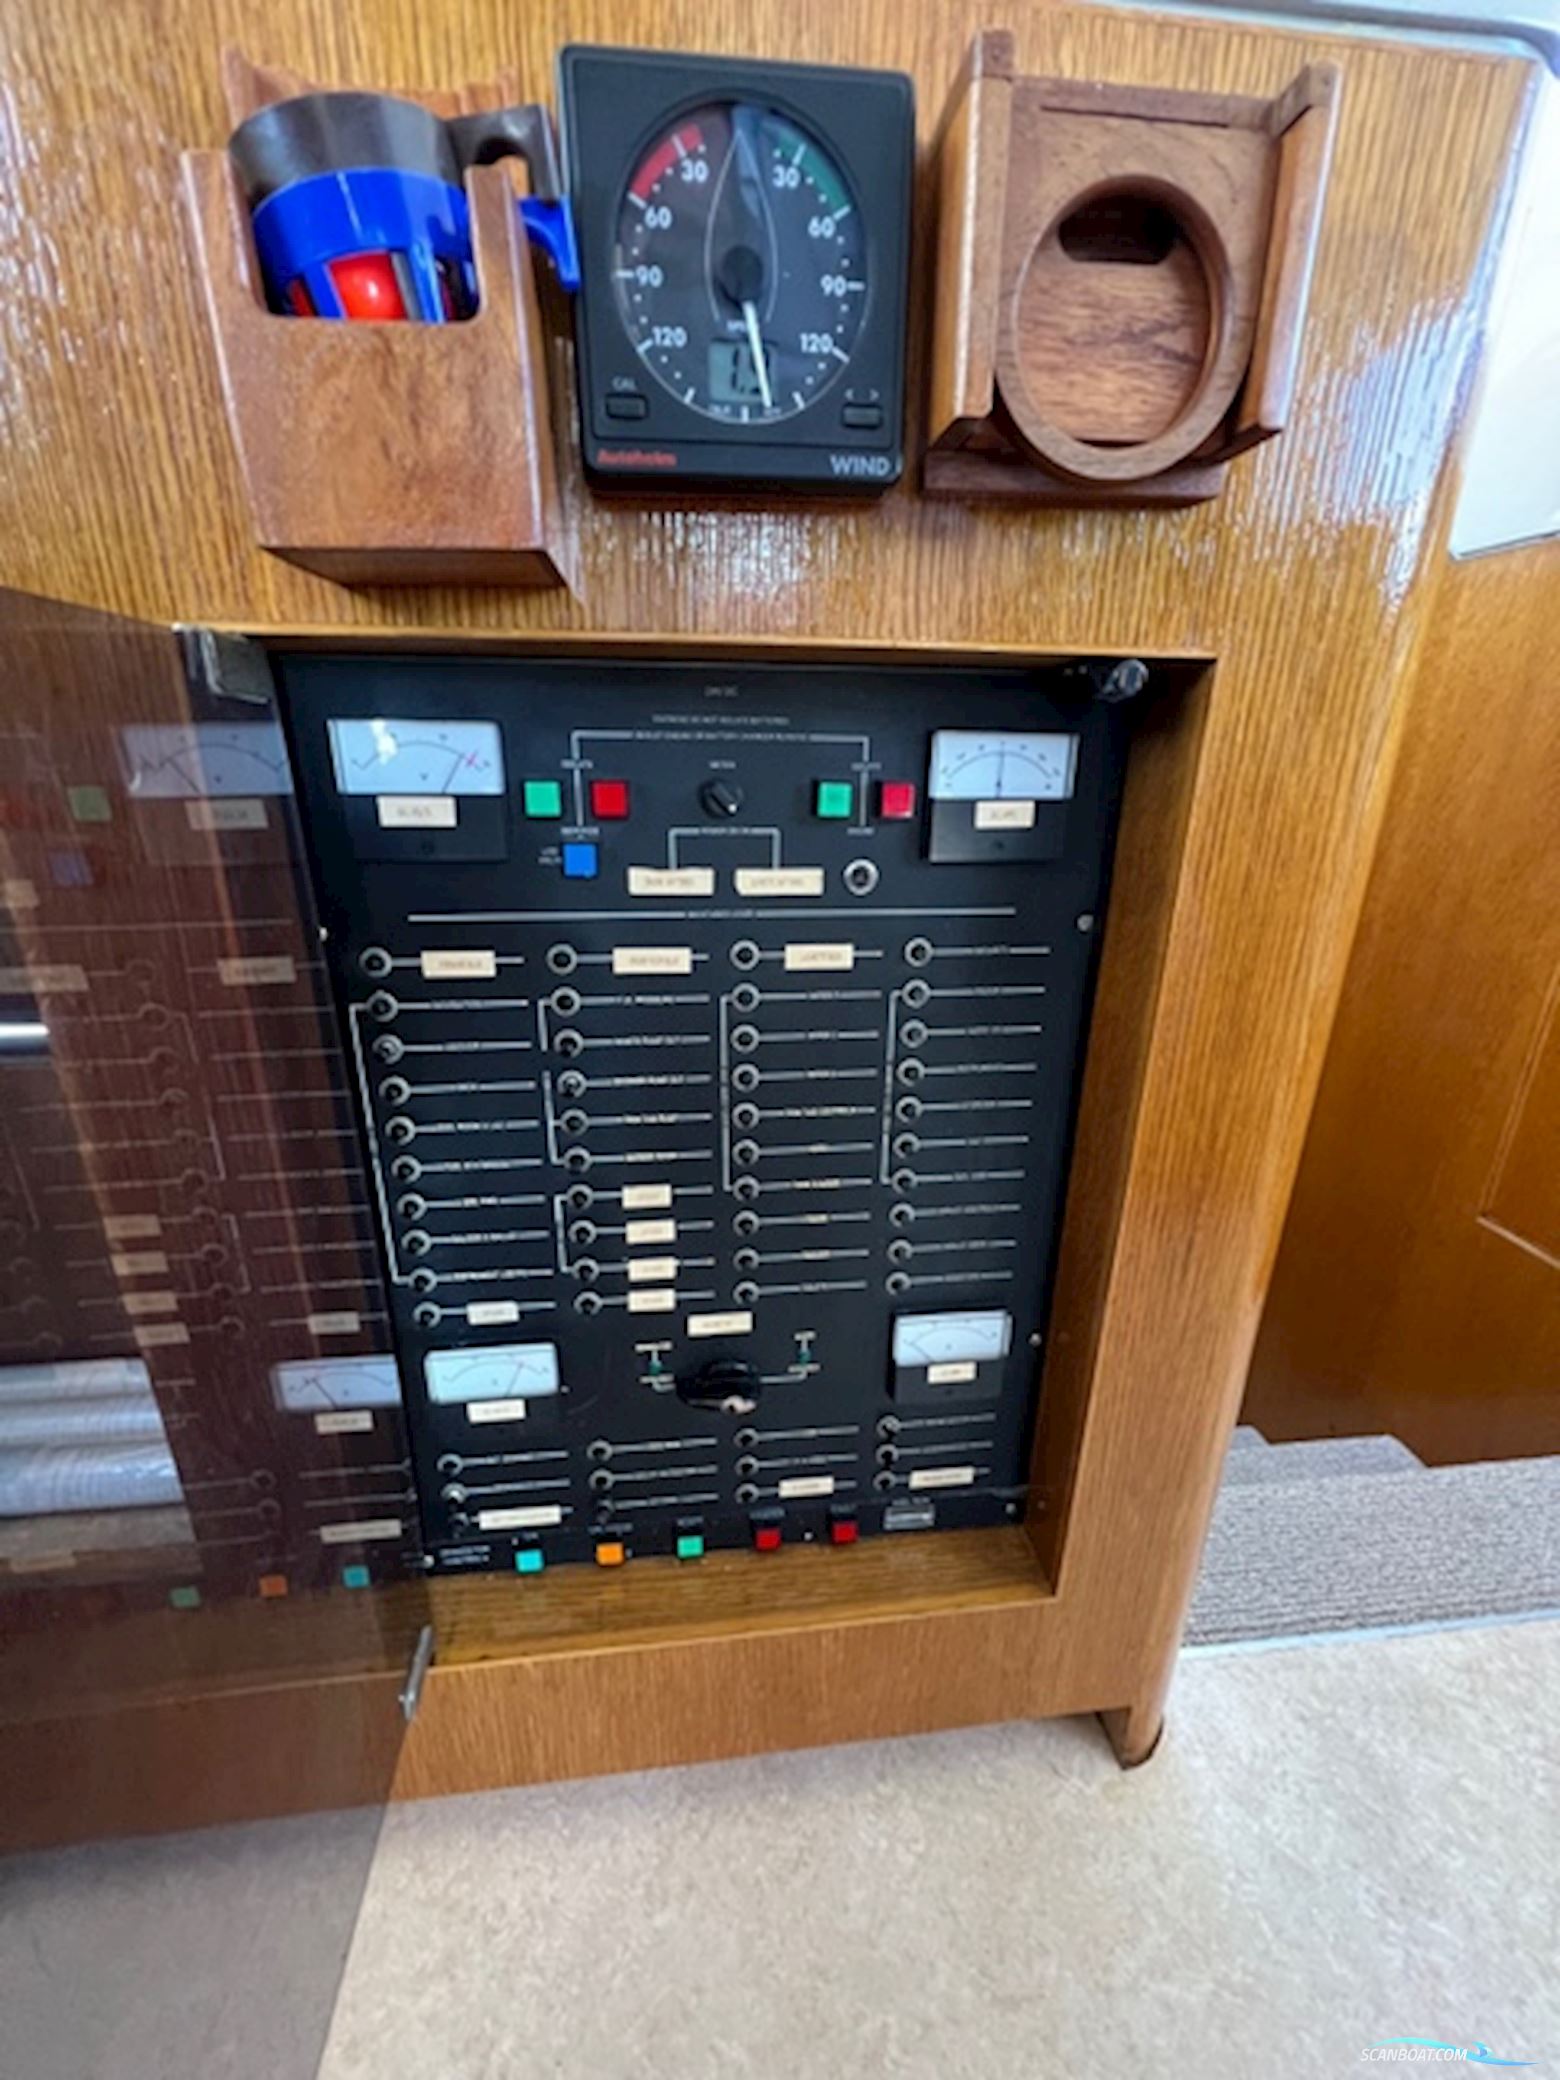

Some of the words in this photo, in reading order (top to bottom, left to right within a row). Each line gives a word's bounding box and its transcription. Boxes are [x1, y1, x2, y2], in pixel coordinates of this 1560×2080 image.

[681, 160, 708, 183] 30
[773, 166, 800, 189] 30
[644, 206, 672, 230] 60
[808, 215, 836, 238] 60
[636, 265, 663, 288] 90
[820, 274, 848, 297] 90
[653, 327, 688, 348] 120
[800, 334, 835, 355] 120
[830, 454, 891, 476] WIND
